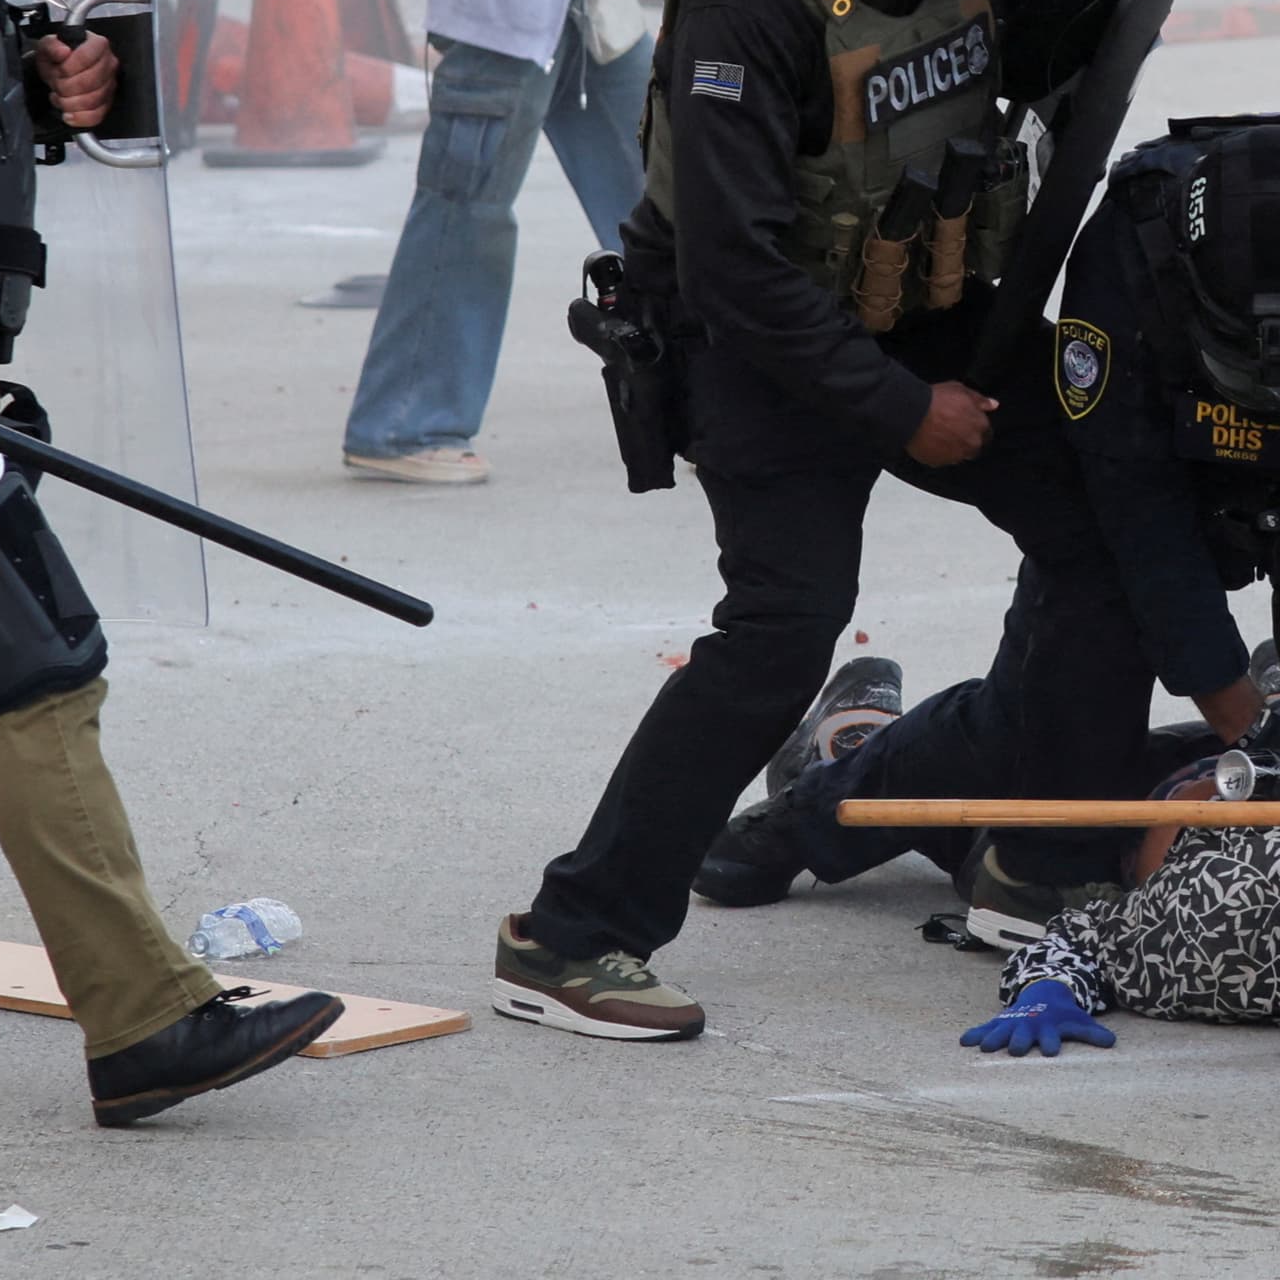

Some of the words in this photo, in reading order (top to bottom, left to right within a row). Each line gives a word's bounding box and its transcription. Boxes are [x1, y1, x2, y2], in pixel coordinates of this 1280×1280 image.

[867, 36, 971, 124] POLICE
[1187, 176, 1207, 241] 855
[1062, 324, 1106, 351] POLICE
[1196, 401, 1280, 430] POL
[1212, 425, 1263, 451] DHS
